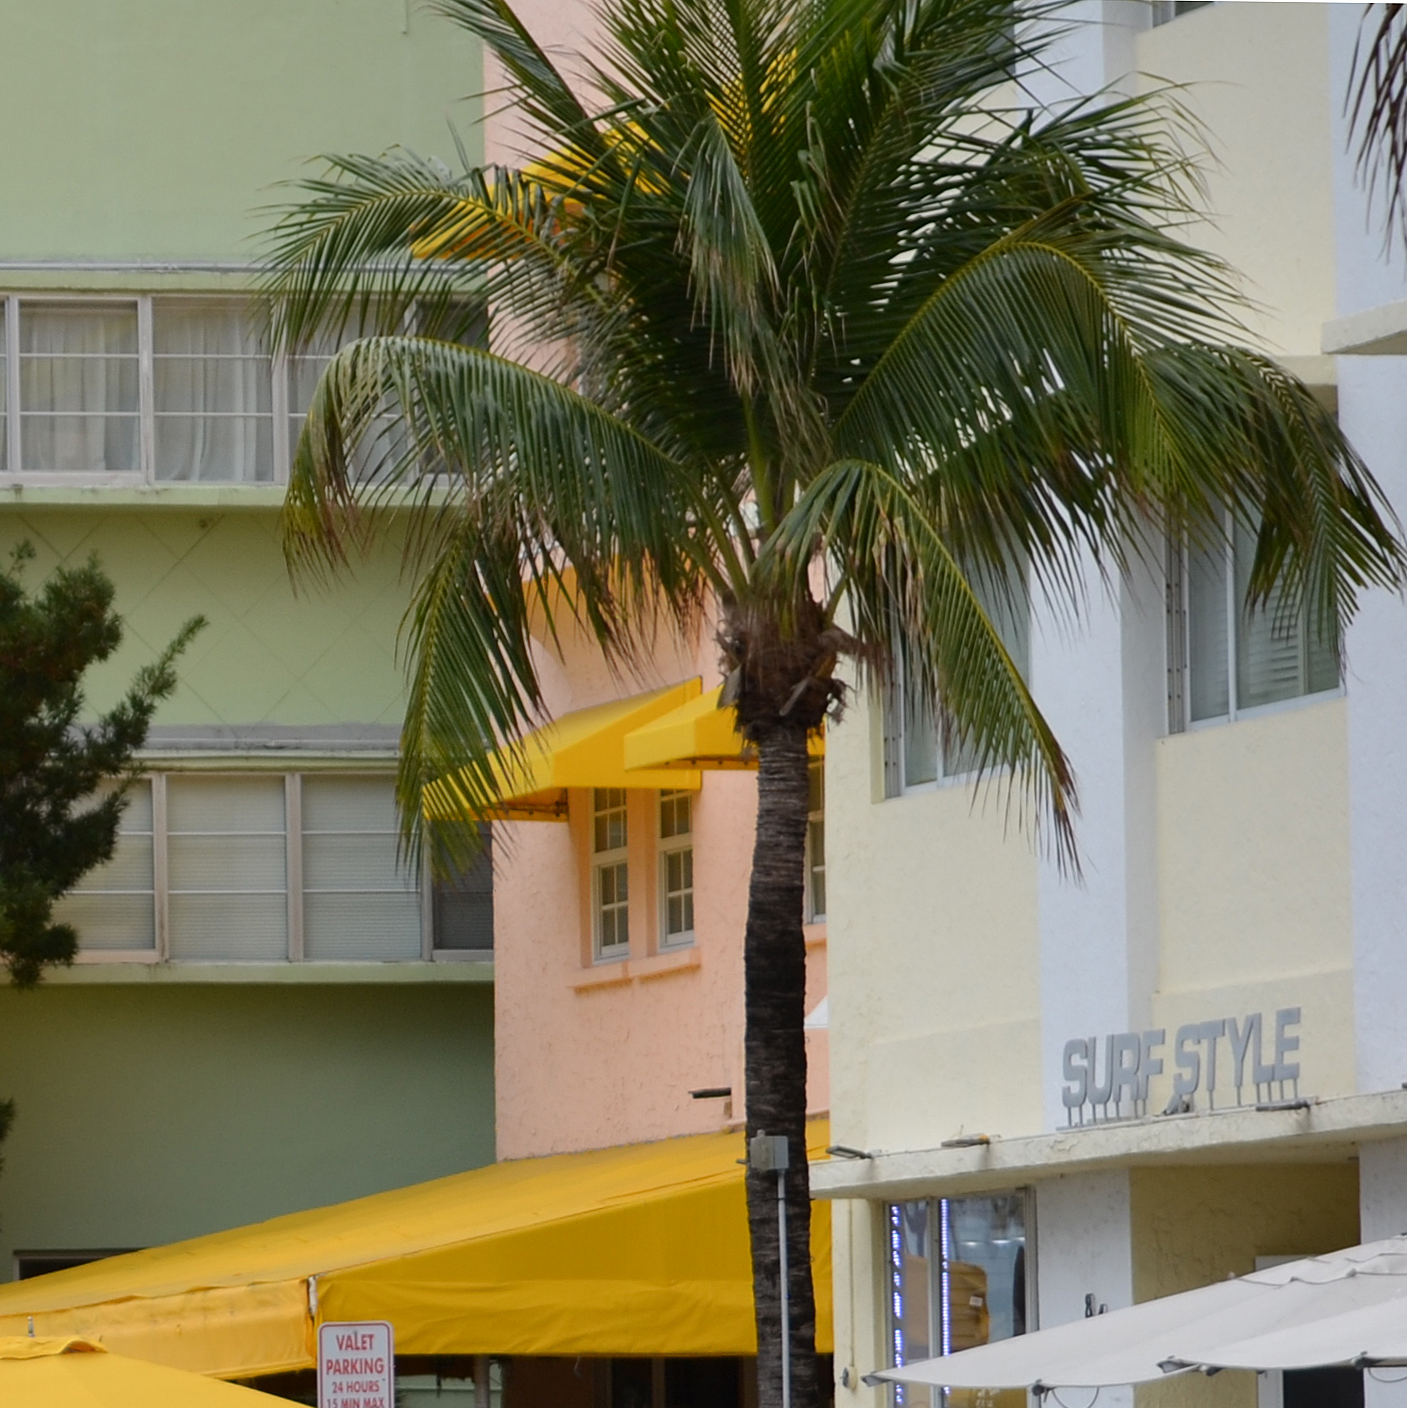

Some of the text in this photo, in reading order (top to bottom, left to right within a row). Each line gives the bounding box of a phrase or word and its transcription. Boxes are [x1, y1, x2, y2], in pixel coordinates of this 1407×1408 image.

[1061, 1006, 1301, 1108] SURF STYLE
[335, 1333, 374, 1351] VALET
[326, 1357, 384, 1375] PARKING
[331, 1380, 380, 1393] 24 HOURS
